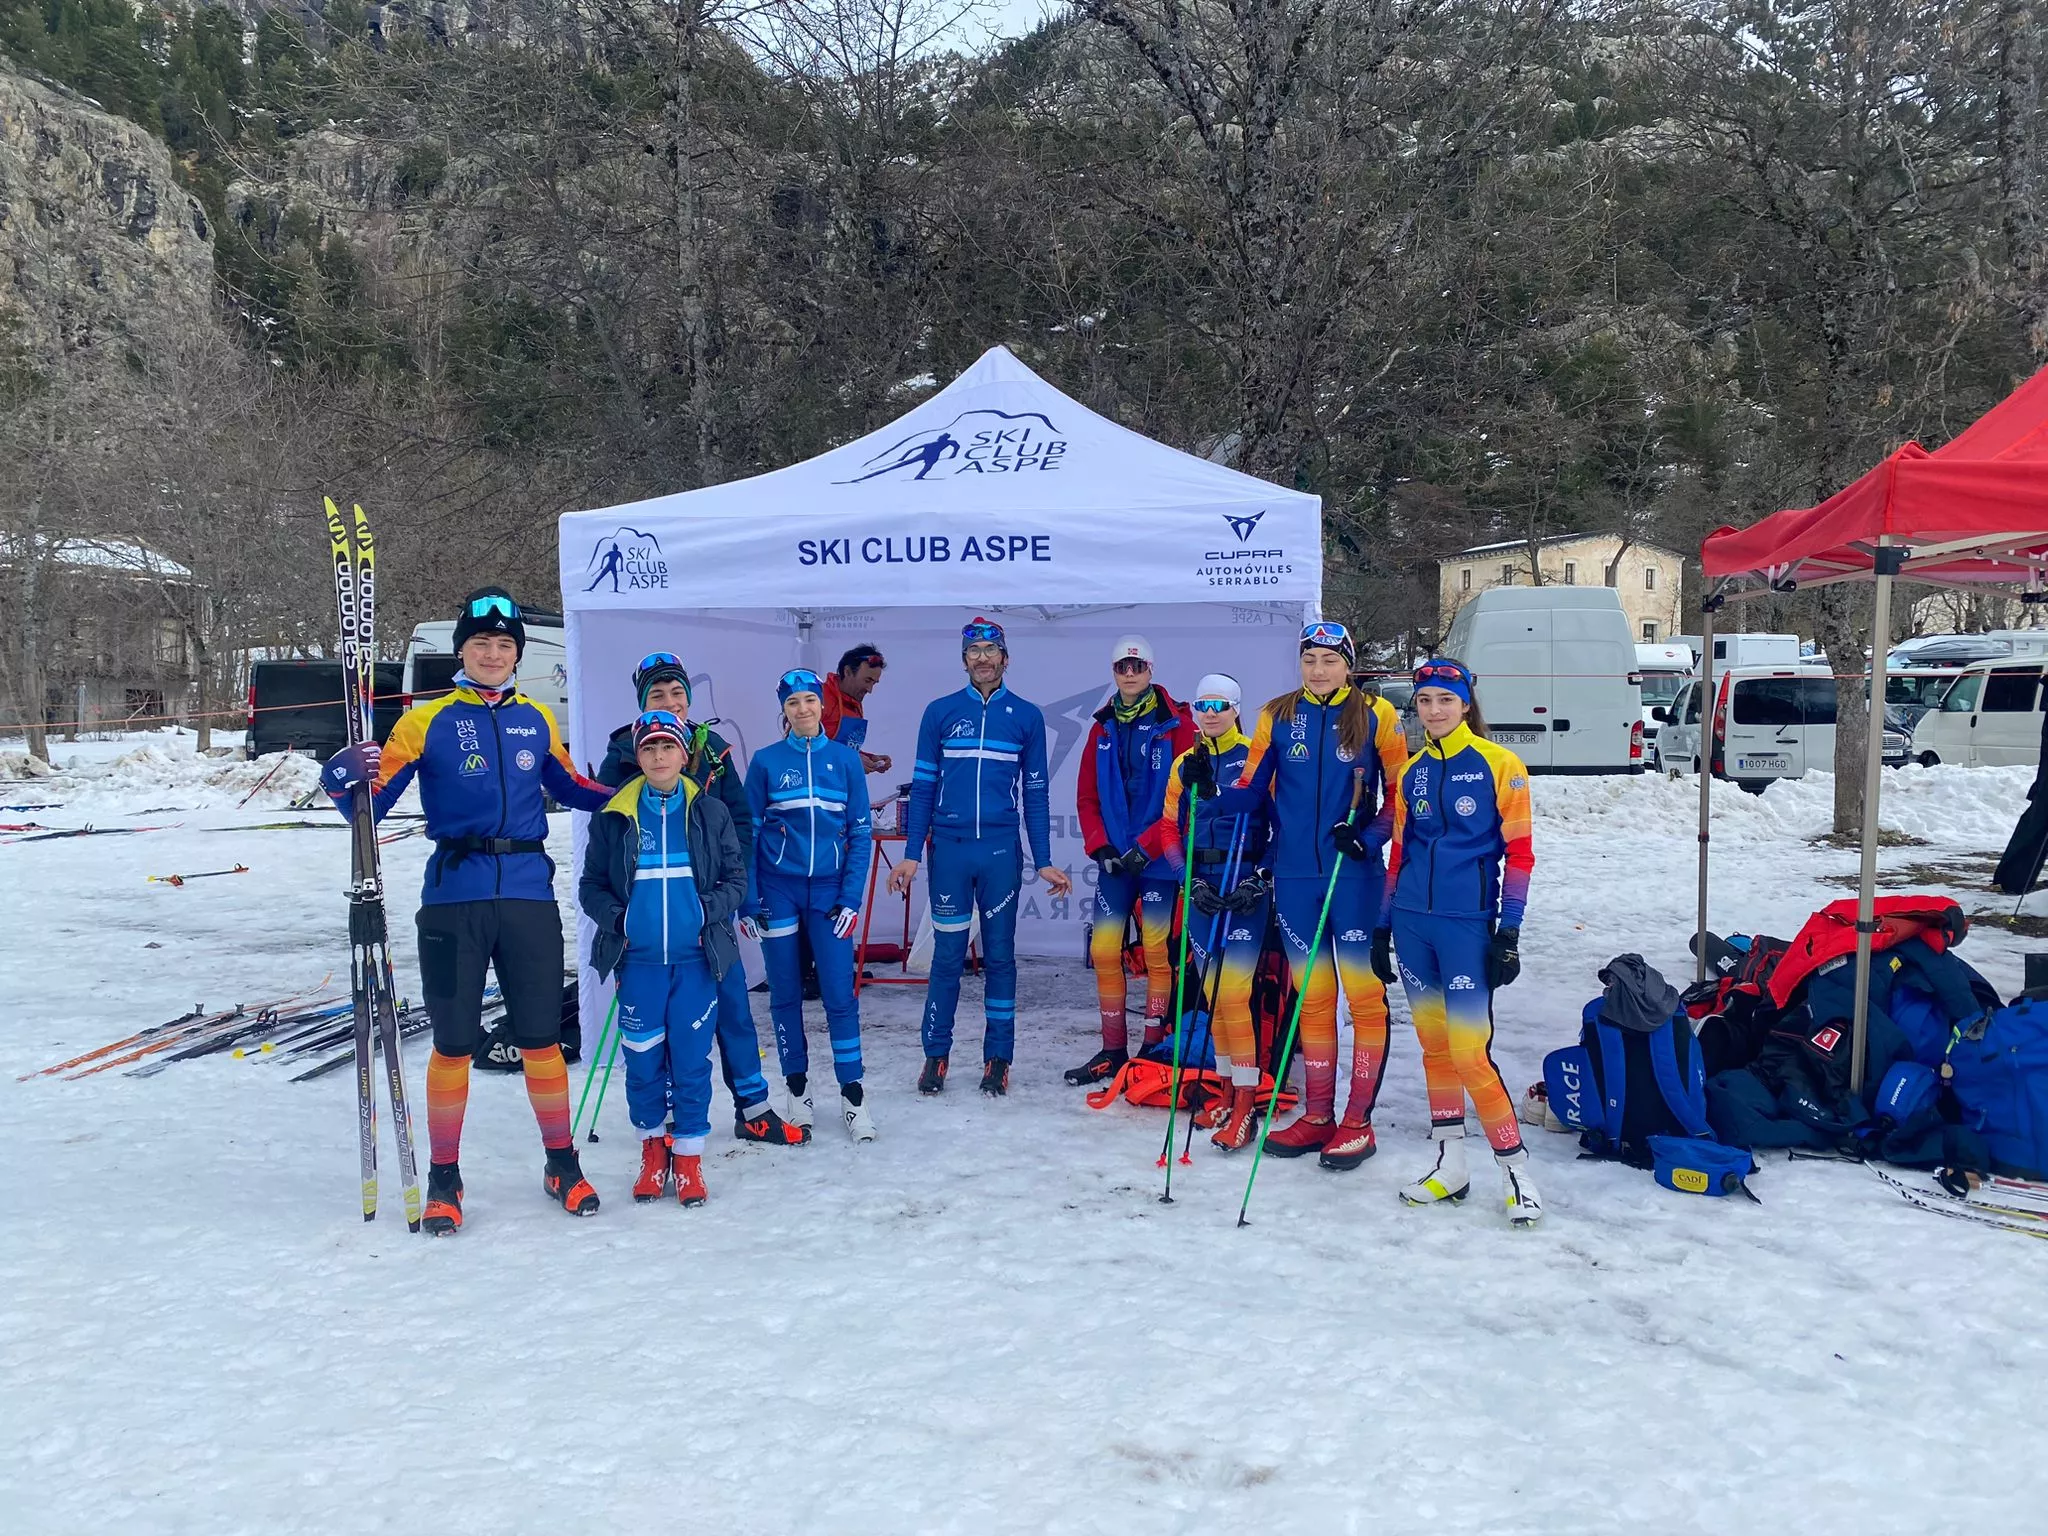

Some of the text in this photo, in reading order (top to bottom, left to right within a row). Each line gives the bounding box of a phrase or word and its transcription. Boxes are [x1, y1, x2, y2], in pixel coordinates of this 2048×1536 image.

[970, 428, 1031, 446] SKI
[964, 441, 1067, 460] CLUB
[954, 455, 1063, 474] ASPE
[626, 547, 651, 560] SKI
[798, 535, 1052, 565] SKI CLUB ASPE
[1205, 549, 1283, 560] CUPRA
[625, 561, 668, 575] CLUB
[1196, 563, 1292, 576] AUTOMÓVILES
[629, 574, 669, 589] ASPE
[1209, 576, 1279, 586] SERRABLO
[1745, 760, 1767, 768] 1007
[778, 1023, 789, 1057] ASP
